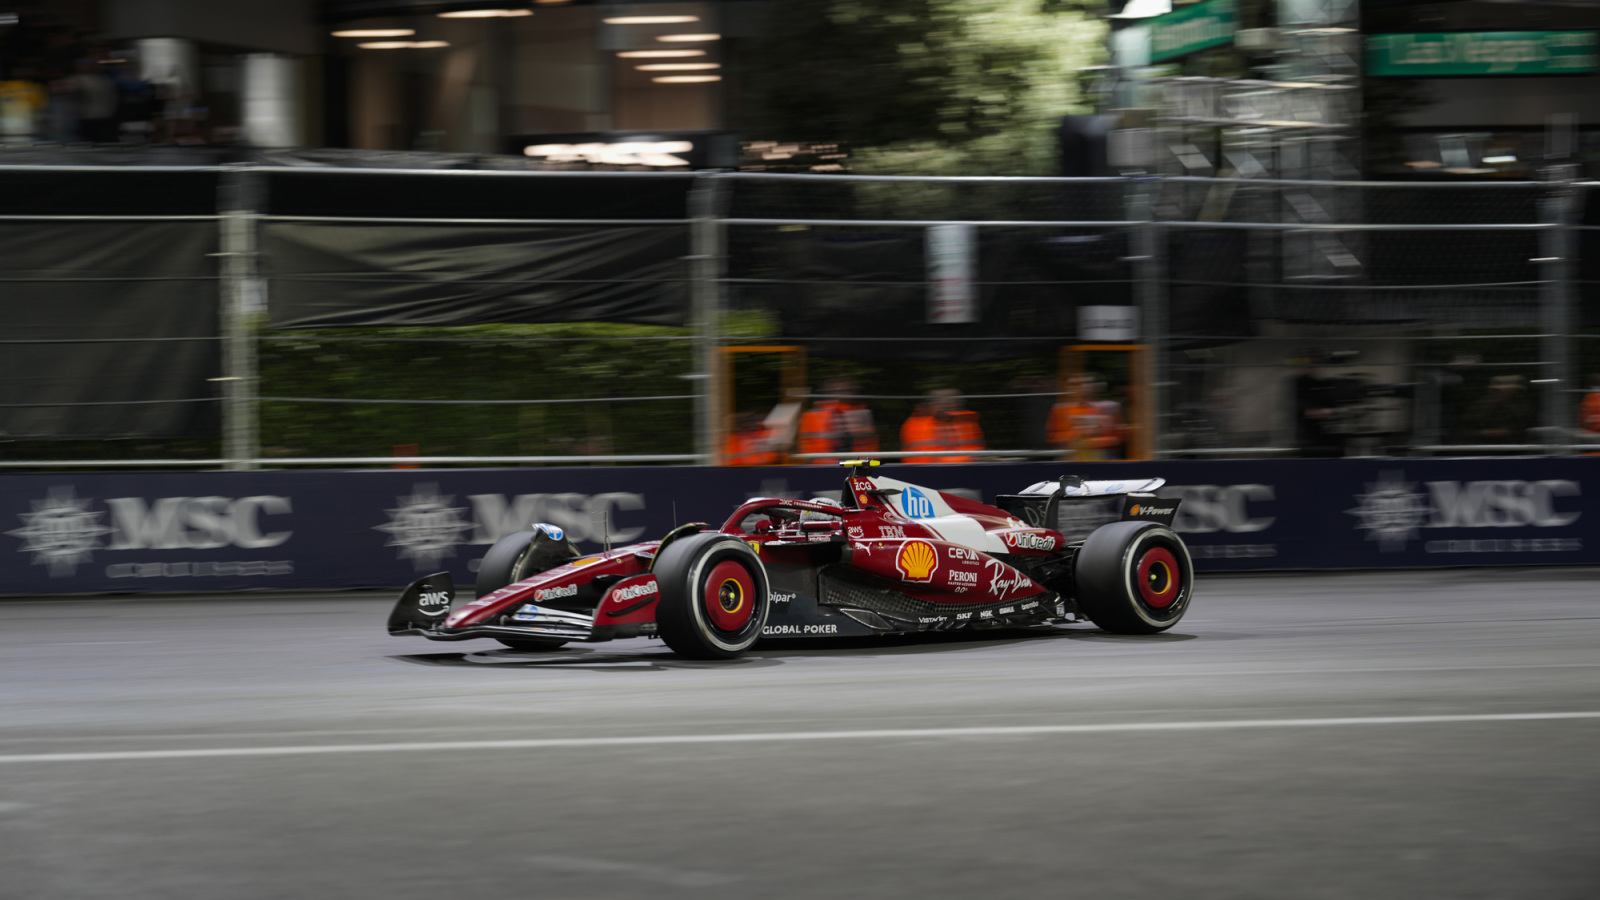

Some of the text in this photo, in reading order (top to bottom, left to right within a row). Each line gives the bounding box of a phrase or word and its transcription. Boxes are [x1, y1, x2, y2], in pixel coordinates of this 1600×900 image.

[854, 482, 872, 490] ZCG
[906, 487, 931, 519] hp
[1139, 507, 1174, 515] V-Power
[878, 525, 907, 538] IBM
[1015, 533, 1055, 551] UniCredit
[948, 569, 978, 583] PERONI
[418, 591, 449, 606] aws
[762, 624, 838, 635] GLOBAL POKER
